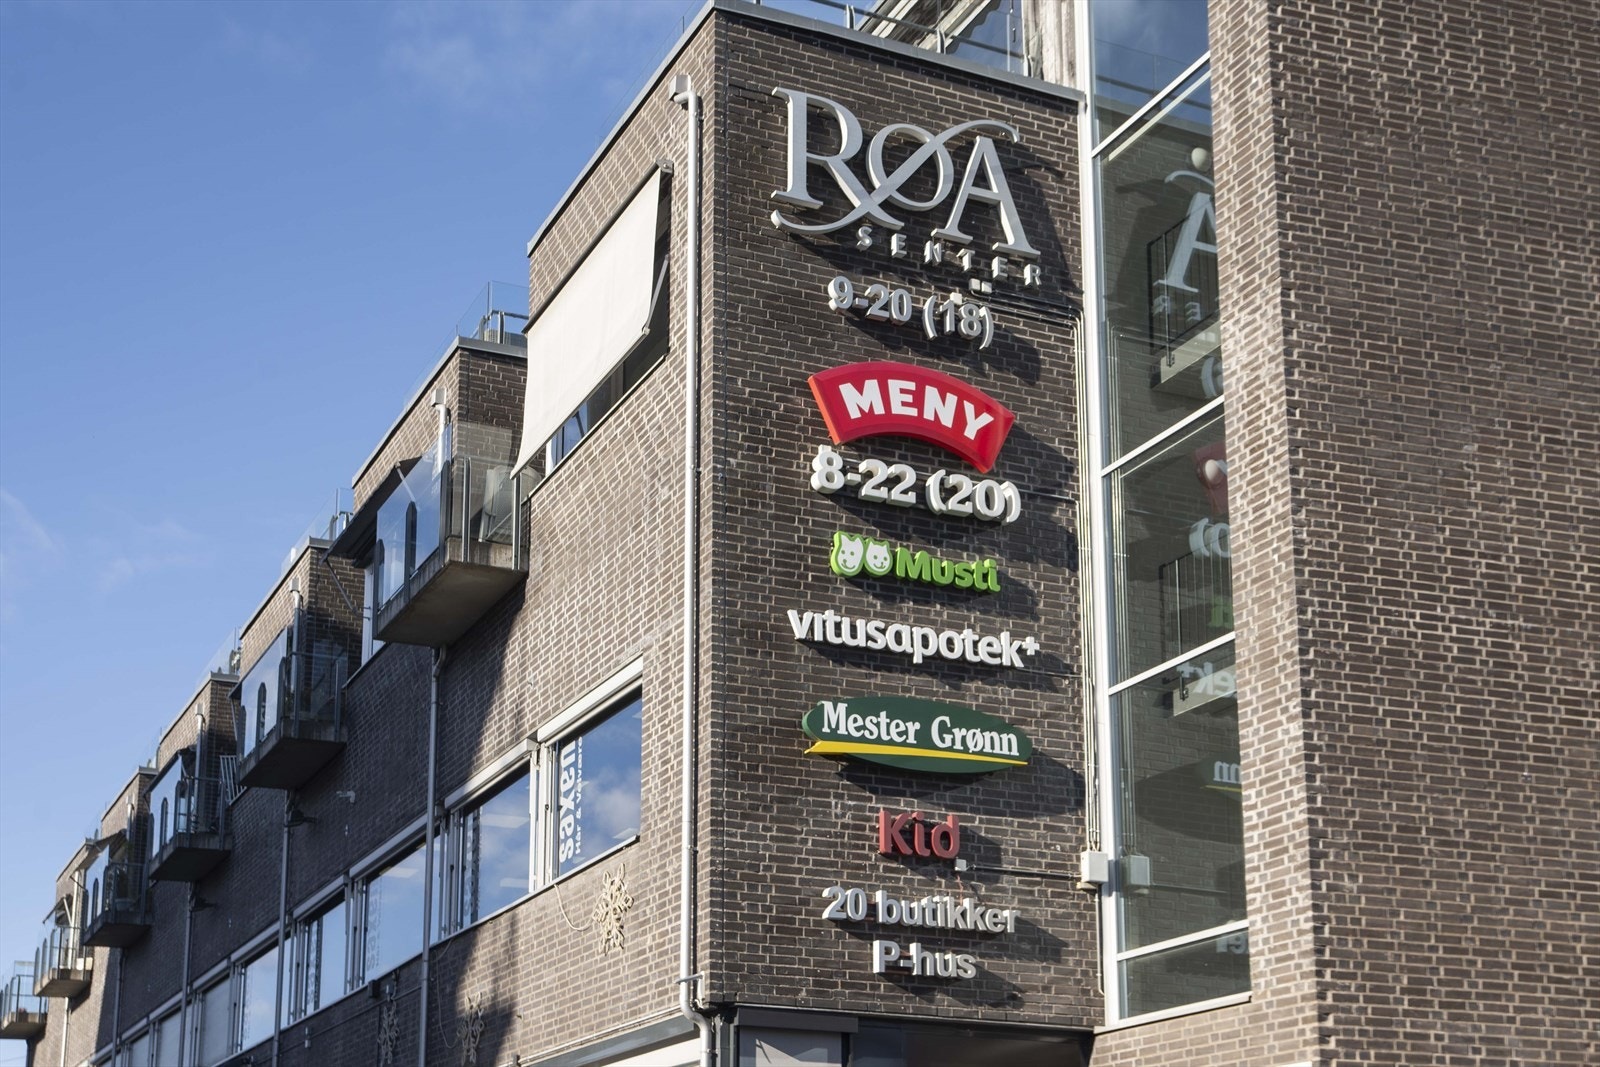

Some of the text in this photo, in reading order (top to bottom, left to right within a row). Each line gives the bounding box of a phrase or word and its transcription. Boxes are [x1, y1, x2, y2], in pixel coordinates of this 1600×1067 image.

[770, 87, 1041, 256] RØA
[856, 226, 1042, 286] SENTER
[828, 276, 994, 349] 9-20 (18)
[839, 379, 994, 440] MENY
[811, 448, 1021, 526] 8-22 (20)
[896, 547, 1000, 592] Musti
[822, 701, 1019, 756] Mester Grønn
[560, 741, 576, 863] saxen
[878, 811, 960, 858] Kid
[822, 886, 1020, 933] 20 butikker
[873, 940, 977, 979] P-hus
